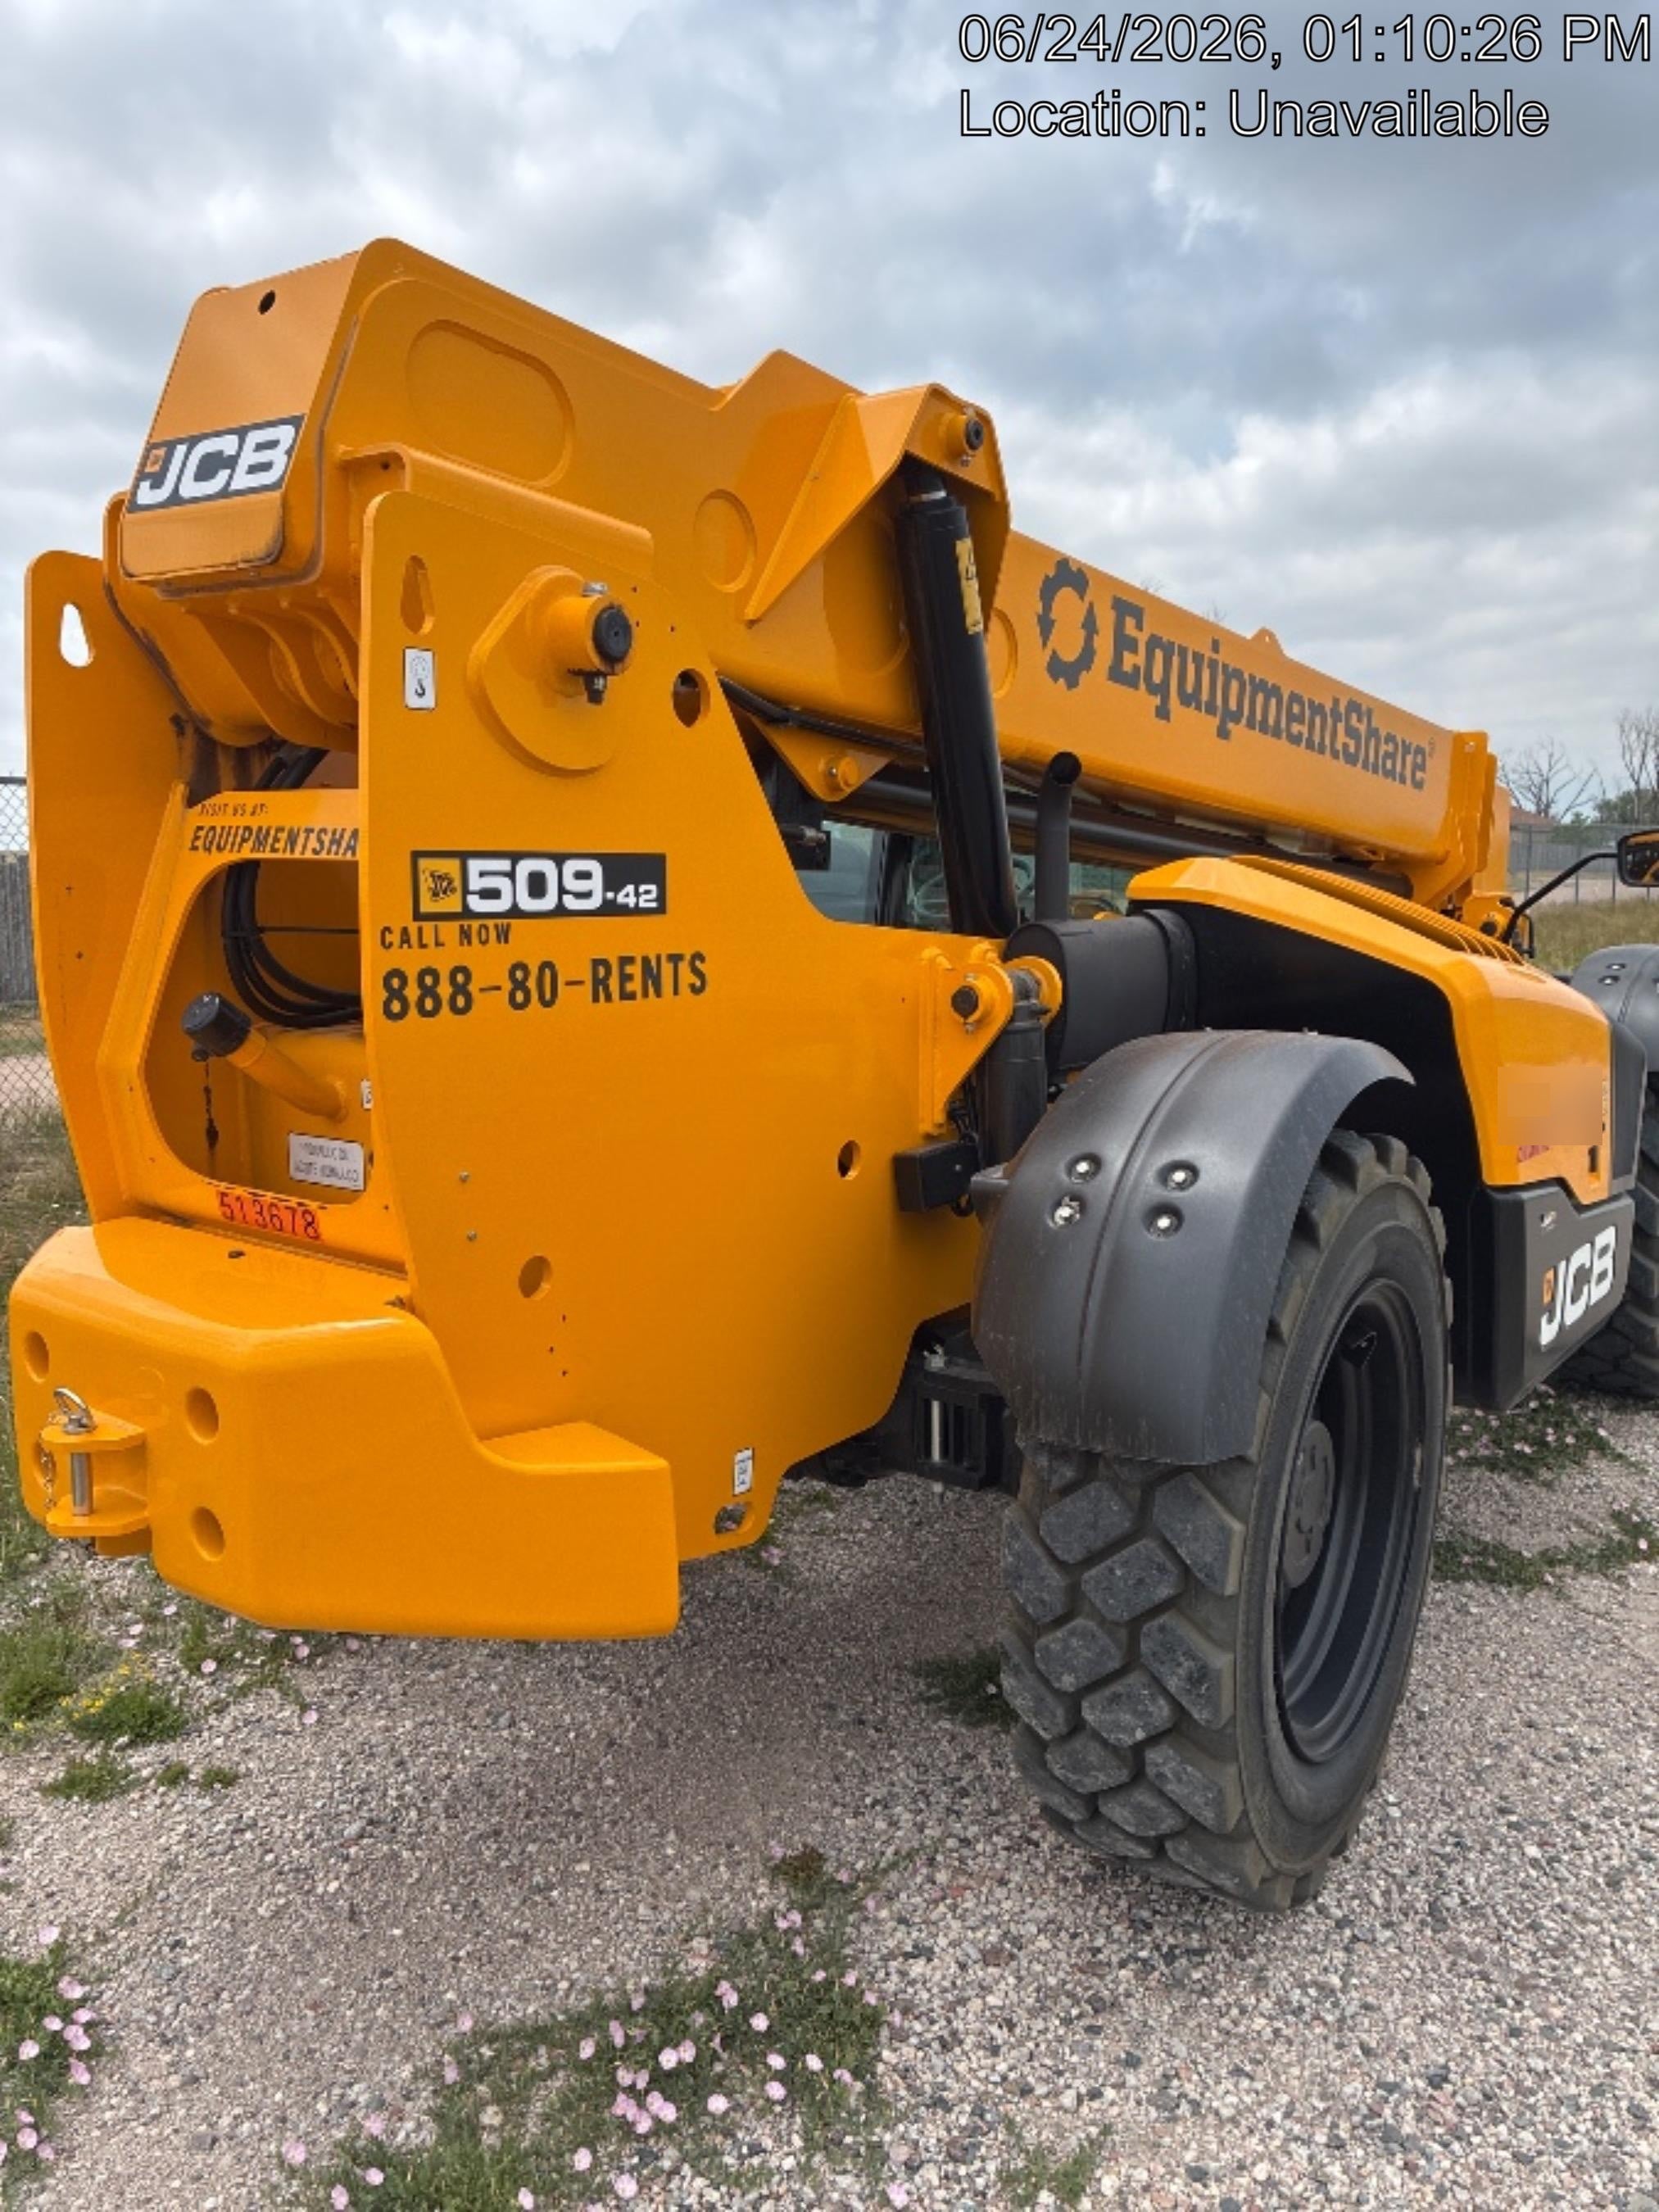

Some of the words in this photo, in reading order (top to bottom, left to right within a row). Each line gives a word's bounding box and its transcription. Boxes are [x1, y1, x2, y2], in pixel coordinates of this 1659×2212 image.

[136, 424, 296, 505] JCB
[380, 925, 445, 950] CALL
[459, 922, 511, 947] NOW
[382, 950, 707, 1022] 888-80-RENTS
[220, 1191, 320, 1240] 513678
[1540, 1226, 1616, 1346] JCB
